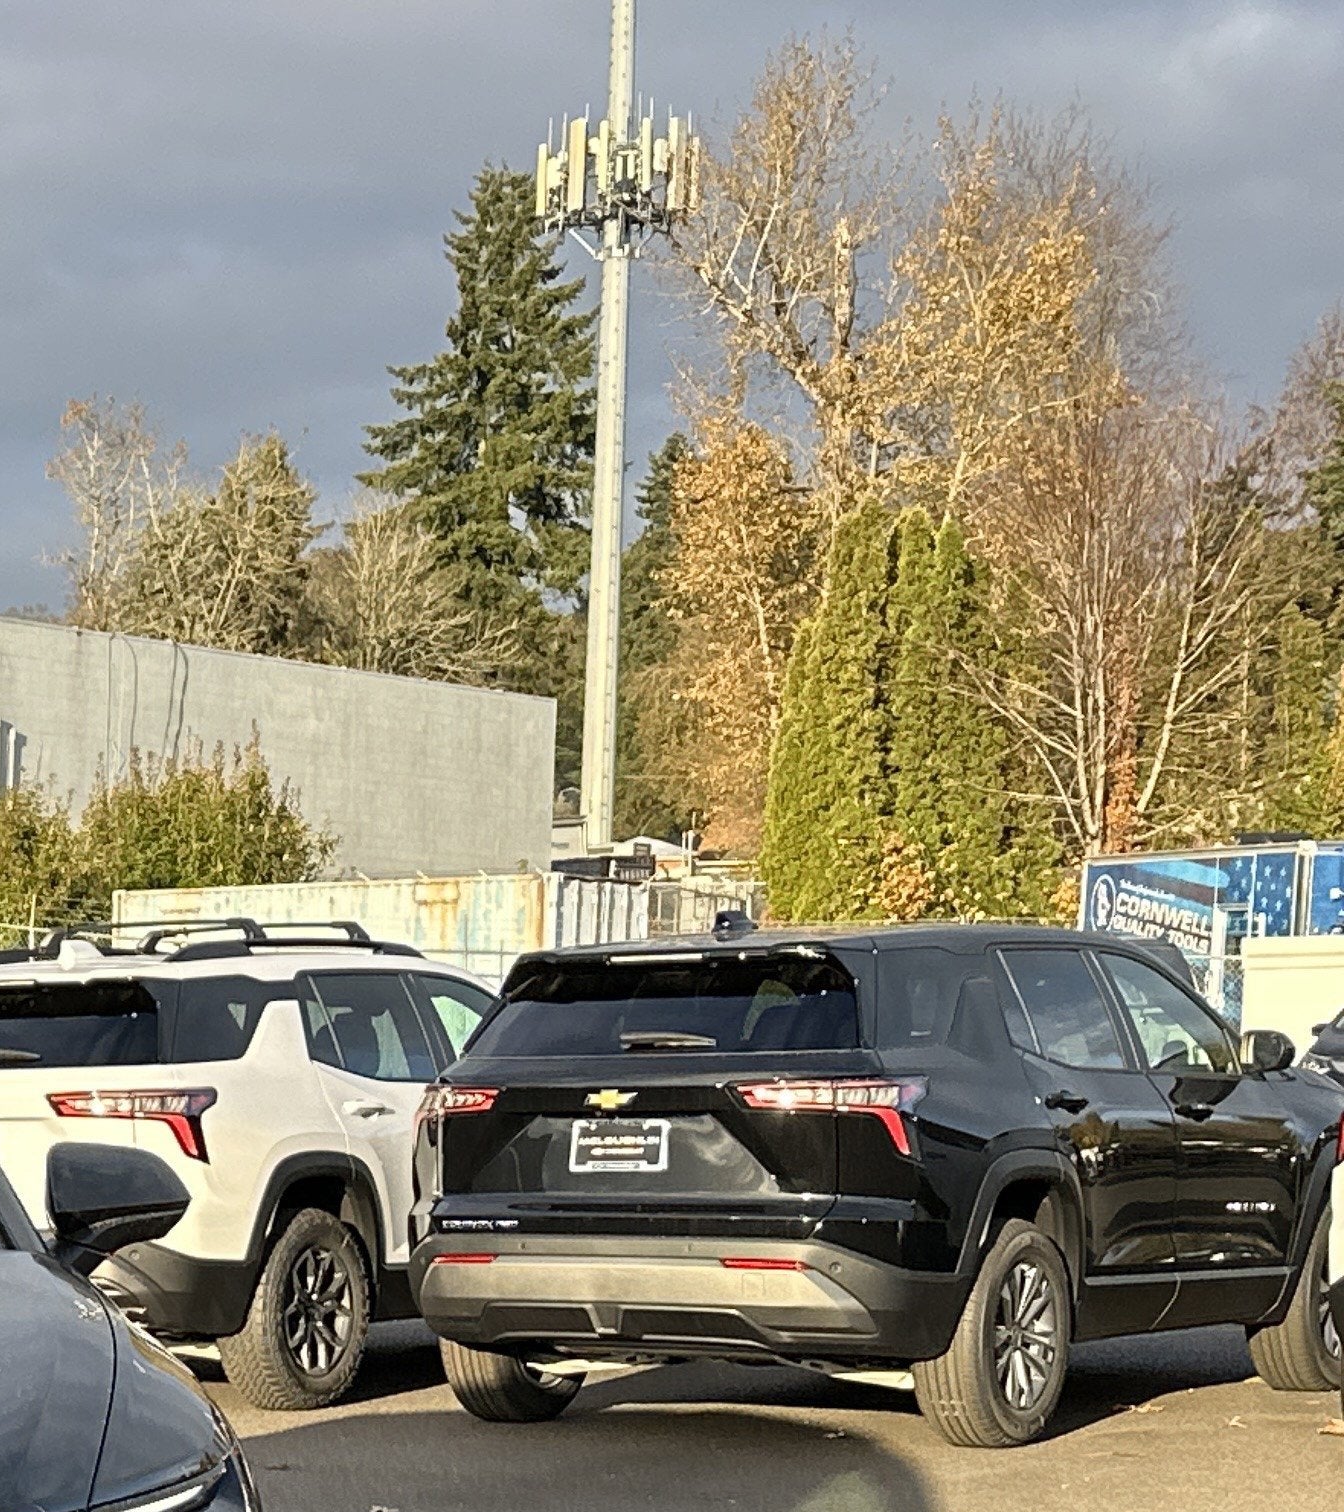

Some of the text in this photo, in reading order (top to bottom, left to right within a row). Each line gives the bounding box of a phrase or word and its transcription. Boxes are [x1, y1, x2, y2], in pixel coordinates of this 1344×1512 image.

[1113, 914, 1210, 954] QUALITY TOOLS
[1116, 892, 1212, 937] CORNWELL
